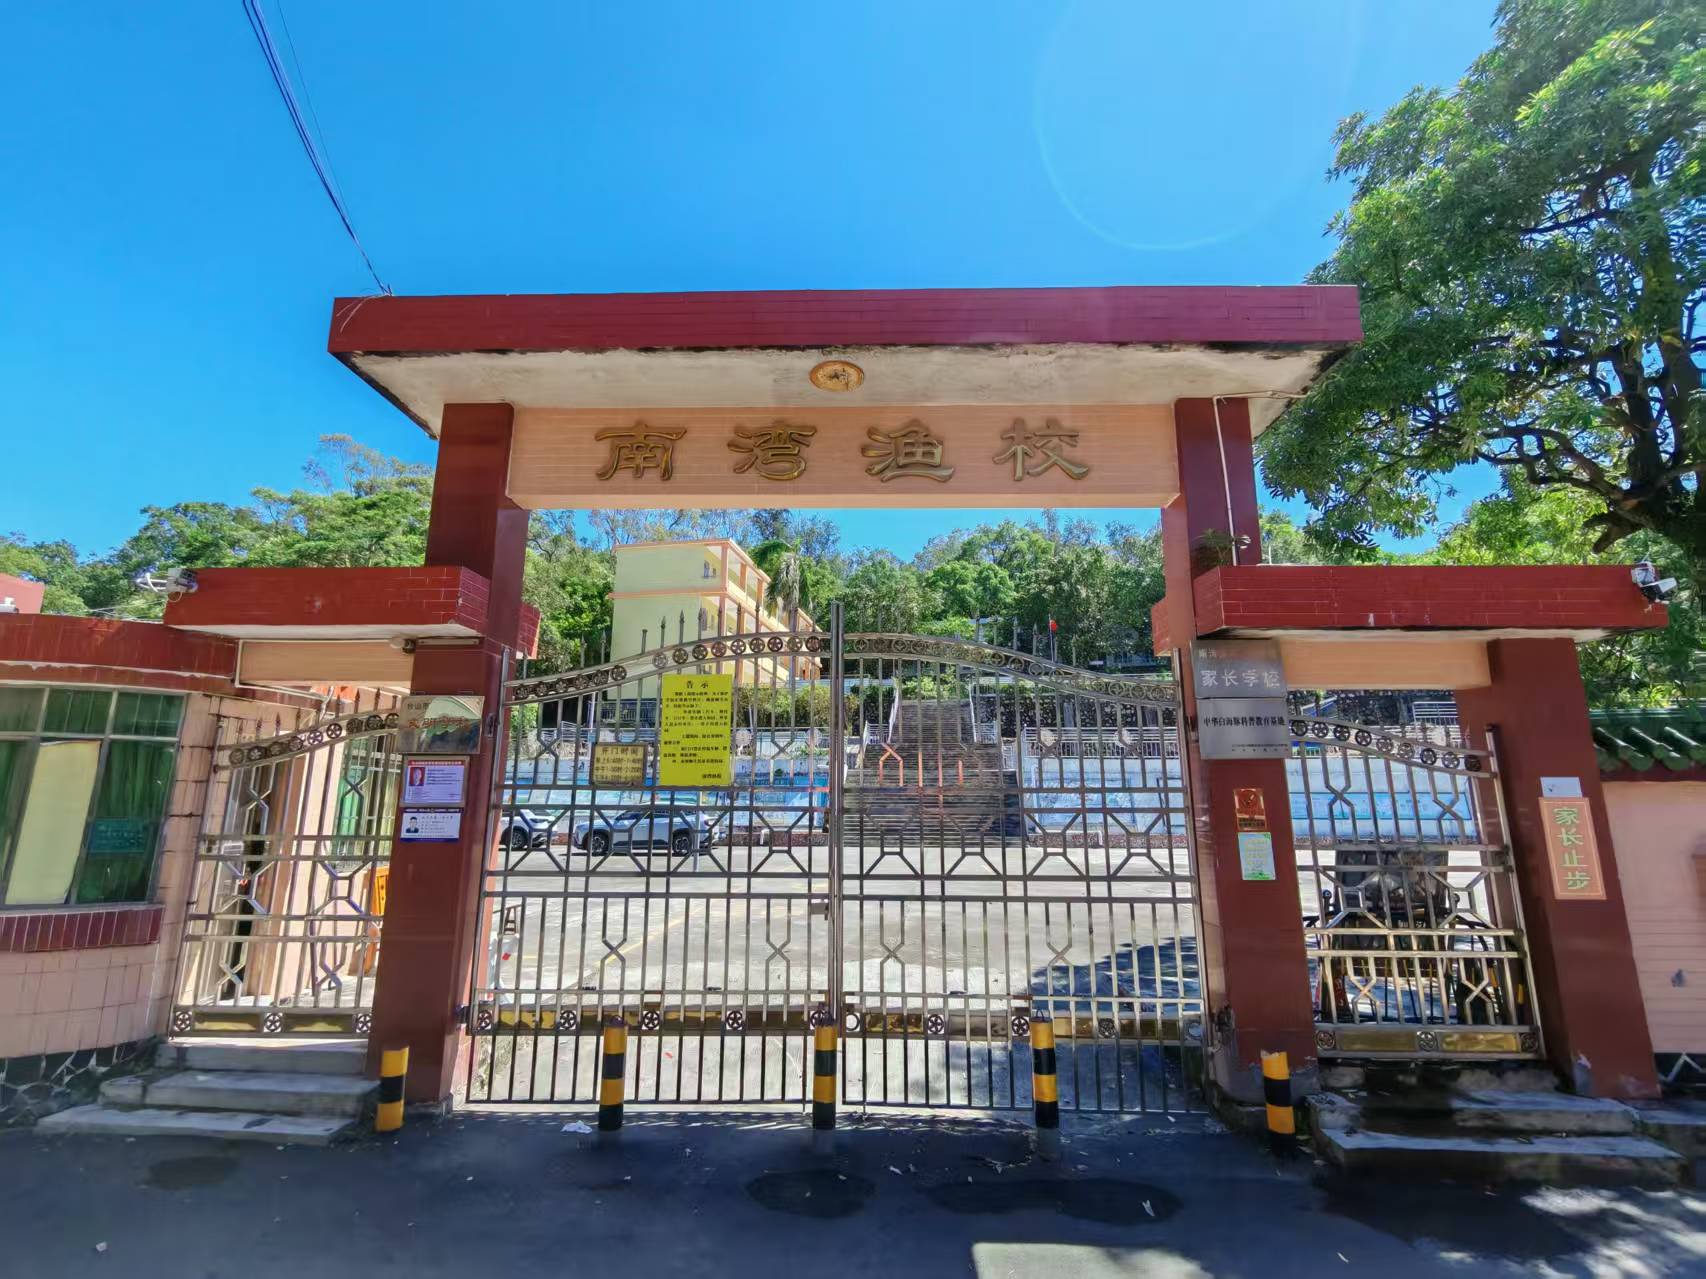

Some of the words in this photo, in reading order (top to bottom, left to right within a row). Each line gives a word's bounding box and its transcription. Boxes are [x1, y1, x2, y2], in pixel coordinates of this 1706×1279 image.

[594, 418, 1091, 482] 南湾渔校
[1553, 807, 1591, 890] 家长止步
